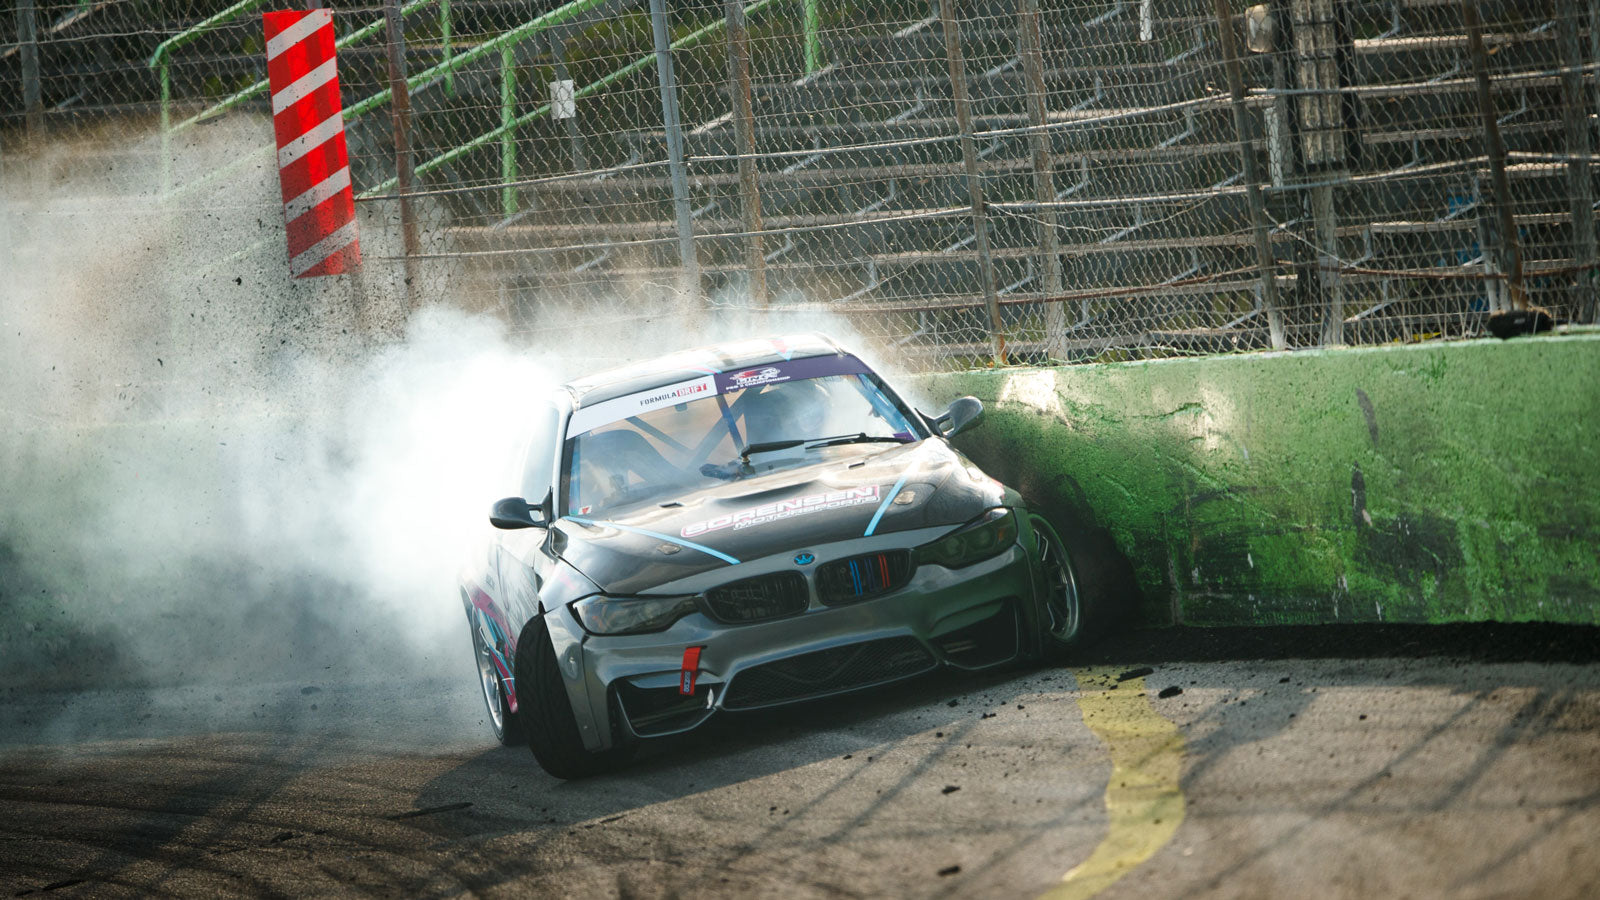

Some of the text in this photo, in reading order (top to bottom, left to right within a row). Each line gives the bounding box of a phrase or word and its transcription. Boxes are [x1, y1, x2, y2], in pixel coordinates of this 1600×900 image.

[640, 383, 707, 407] FORMULA DRIFT
[683, 486, 878, 536] SORENSEN
[733, 496, 880, 530] MOTORSPORTS
